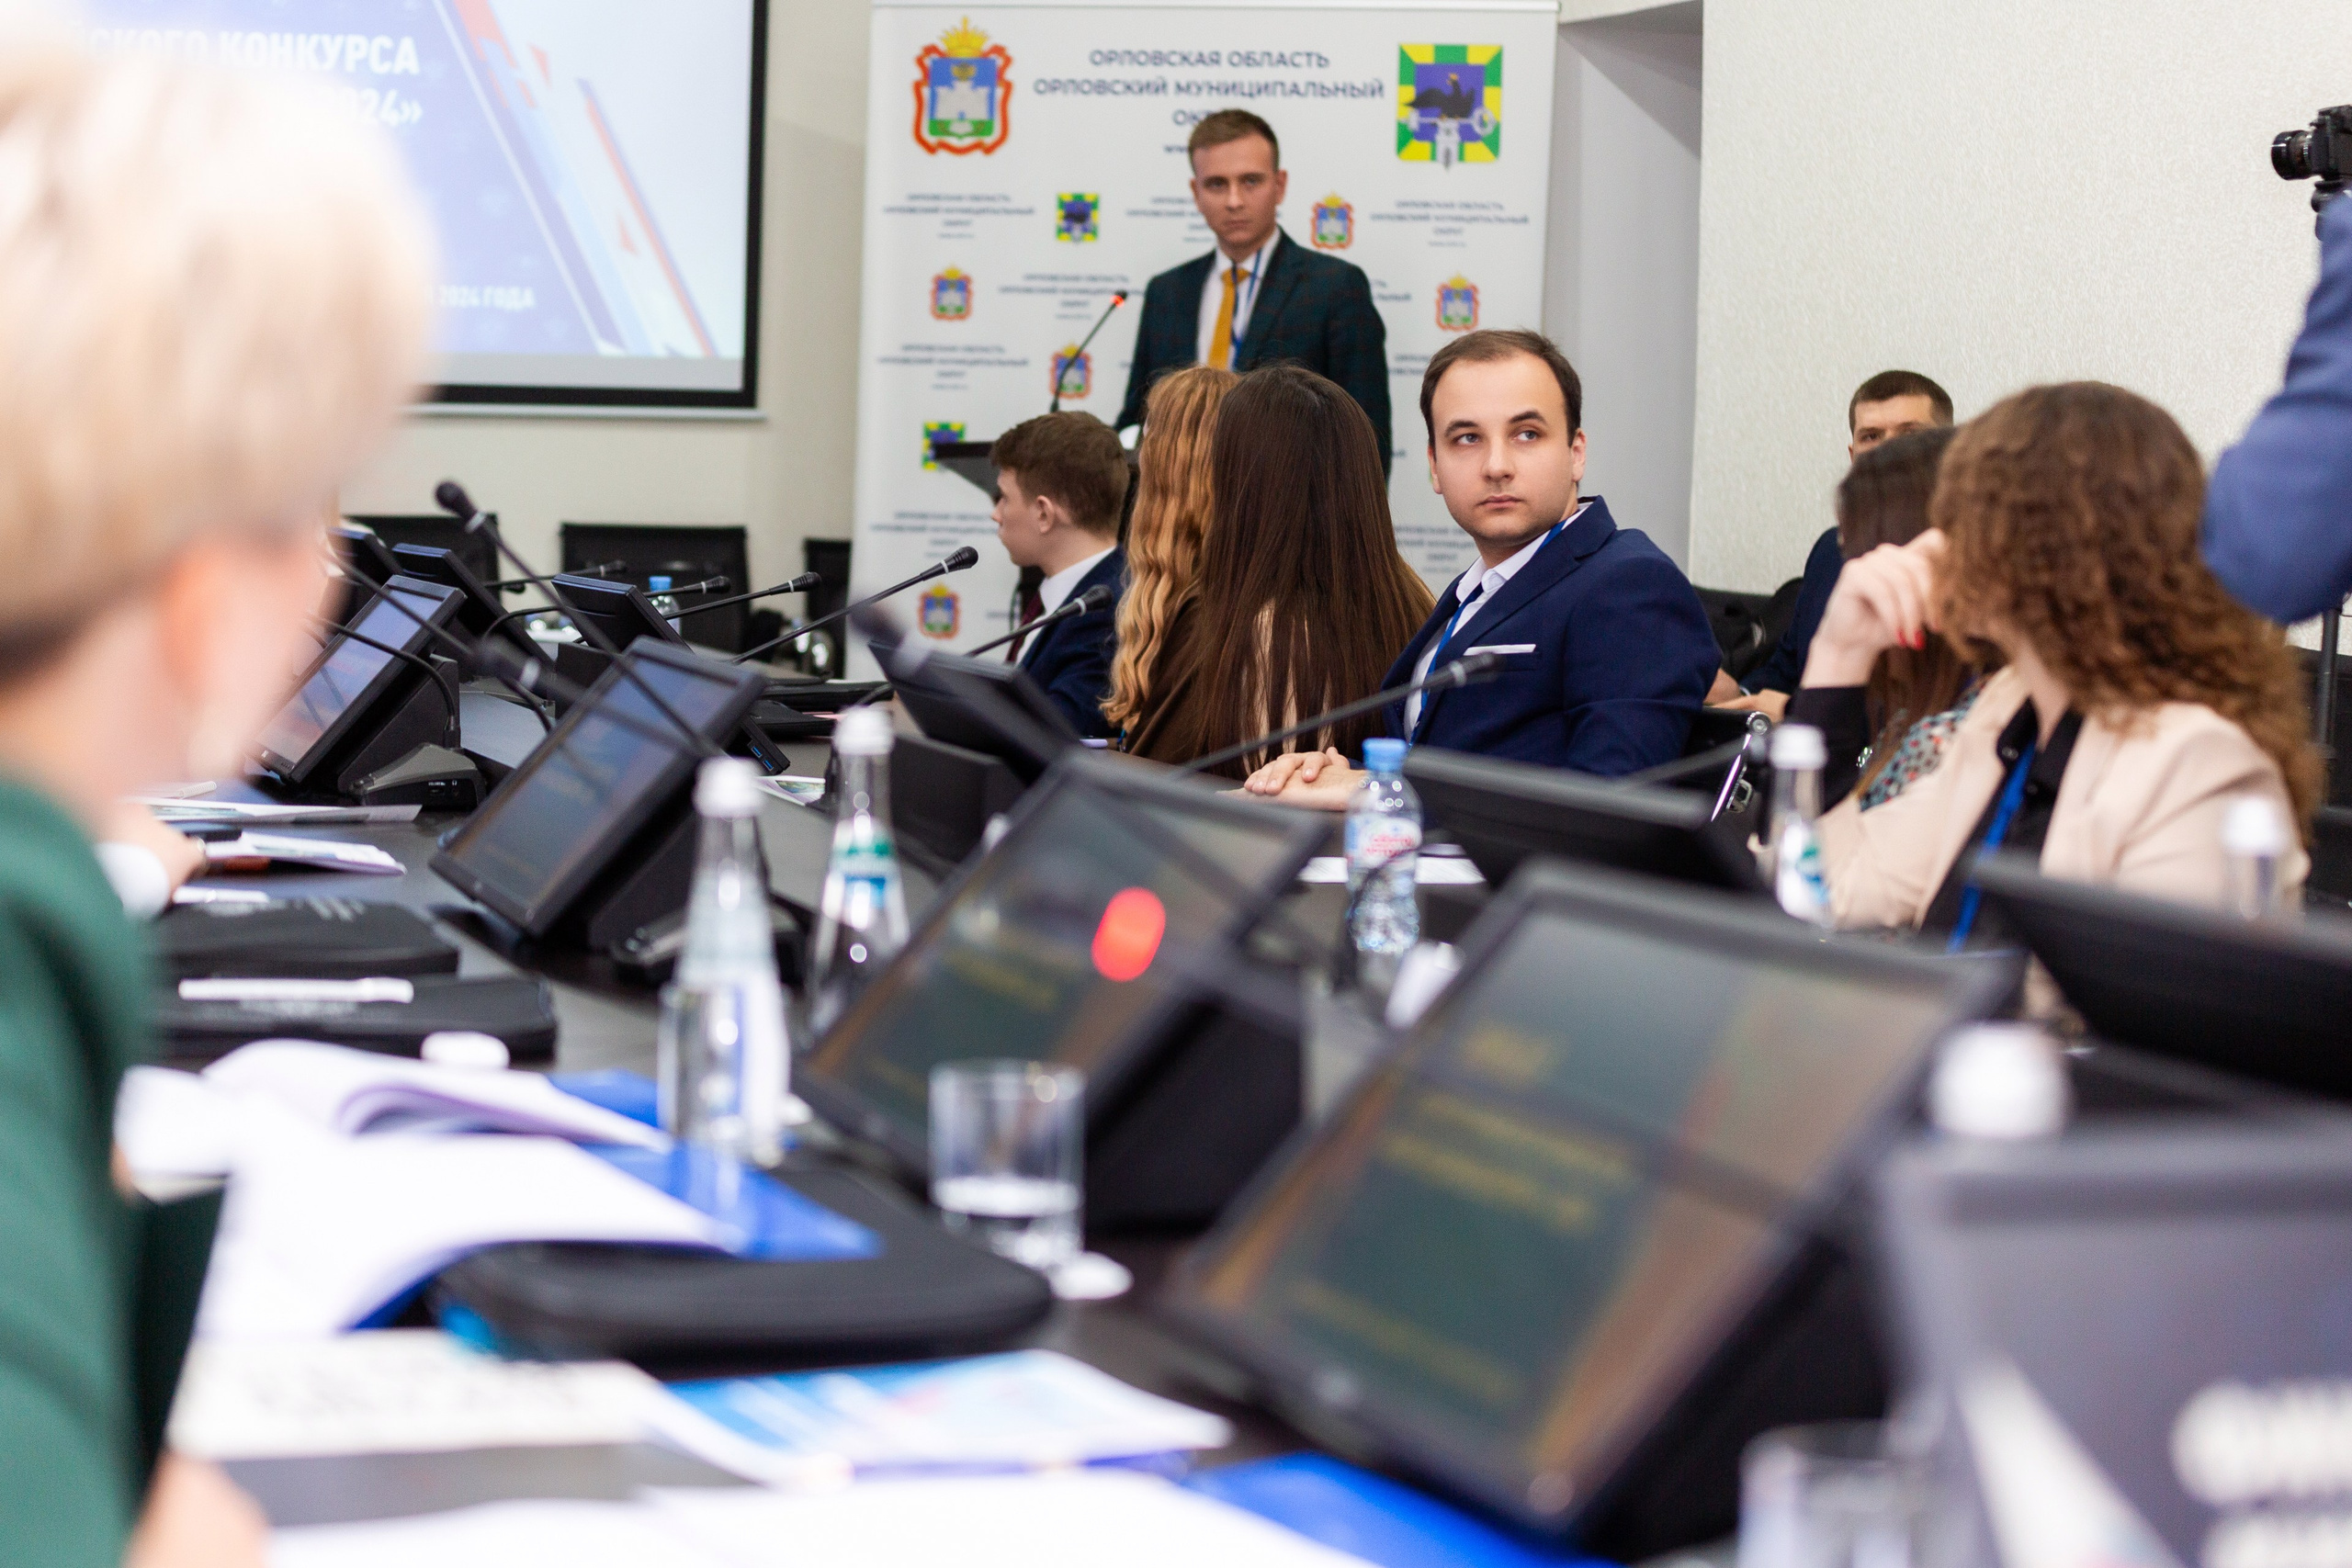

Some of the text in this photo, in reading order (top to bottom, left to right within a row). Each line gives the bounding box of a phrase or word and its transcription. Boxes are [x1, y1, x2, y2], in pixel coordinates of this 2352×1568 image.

[219, 30, 421, 75] КОНКУРСА
[1089, 50, 1330, 69] ОРЛОВСКАЯ ОБЛАСТЬ
[1033, 76, 1385, 98] ОРЛОВСКИЙ МУНИЦИПАЛЬНЫЙ
[482, 285, 535, 311] ГОДА
